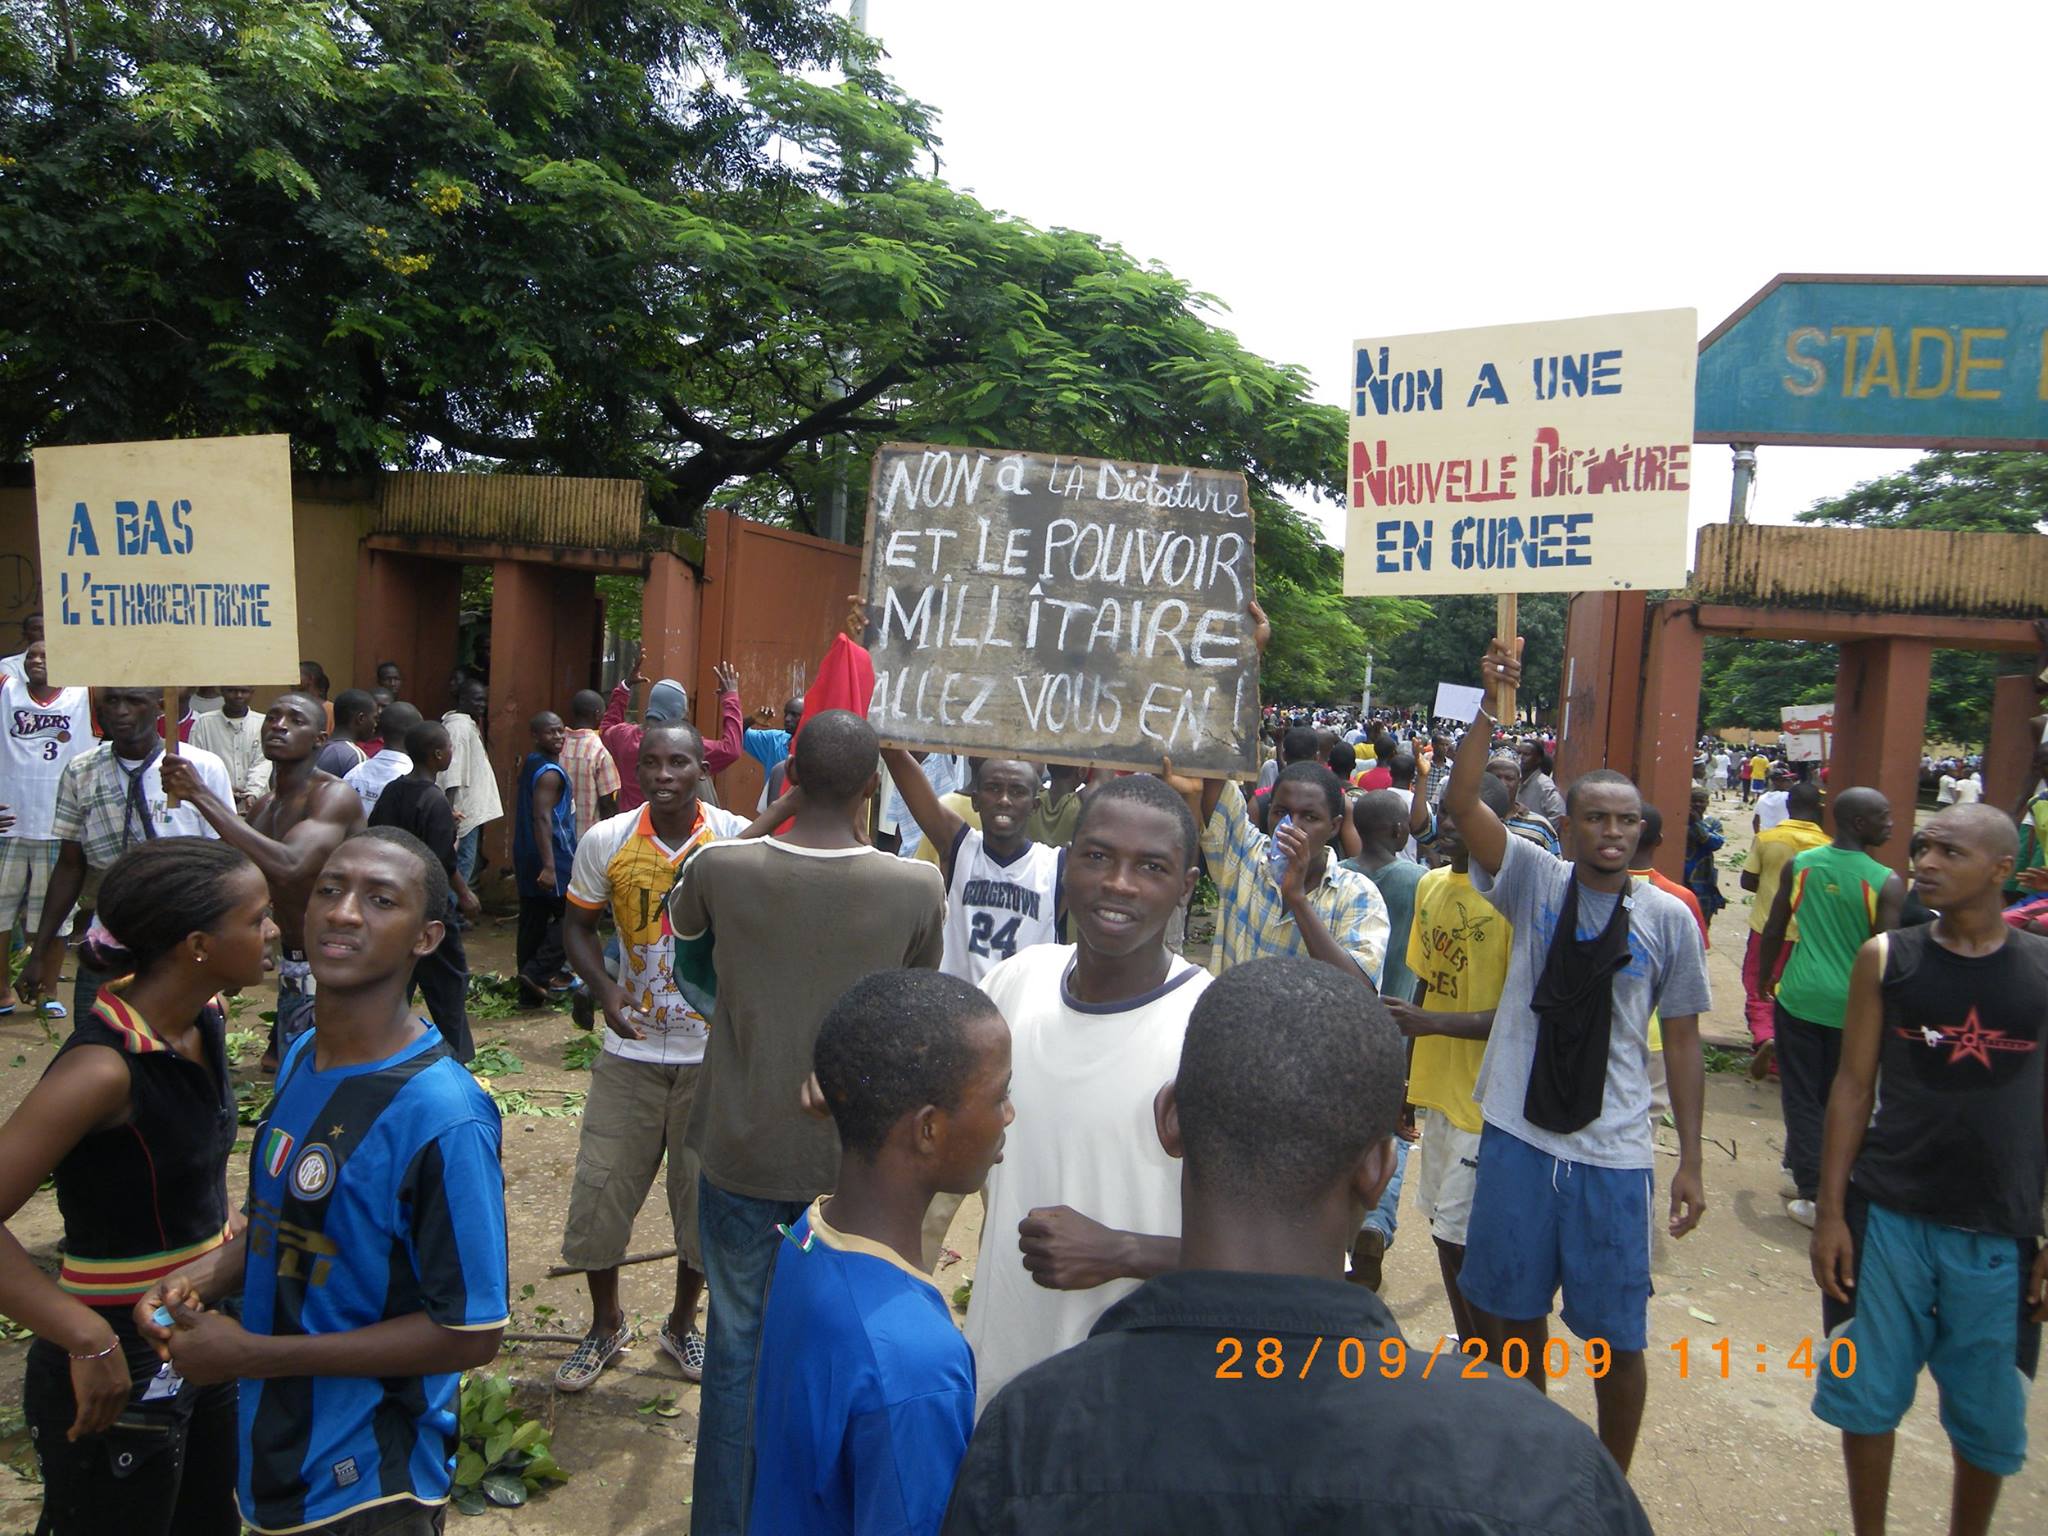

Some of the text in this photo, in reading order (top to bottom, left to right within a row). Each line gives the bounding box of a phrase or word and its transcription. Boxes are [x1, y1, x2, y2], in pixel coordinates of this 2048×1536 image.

[1356, 347, 1623, 416] NON A UNE
[1783, 326, 2007, 401] STADE
[879, 451, 991, 518] NON
[1048, 457, 1085, 501] LA
[1353, 440, 1517, 508] NOUVELLE
[67, 499, 194, 556] A BAS
[885, 516, 1245, 605] ET LE POUVOIR
[1376, 513, 1594, 573] EN GUINEE
[61, 572, 271, 627] L'ETHNOCENTRISME
[867, 667, 997, 730] ALLEZ
[1012, 671, 1127, 734] VOUS
[1139, 681, 1216, 752] EN
[43, 741, 58, 761] 3
[968, 911, 1023, 960] 24
